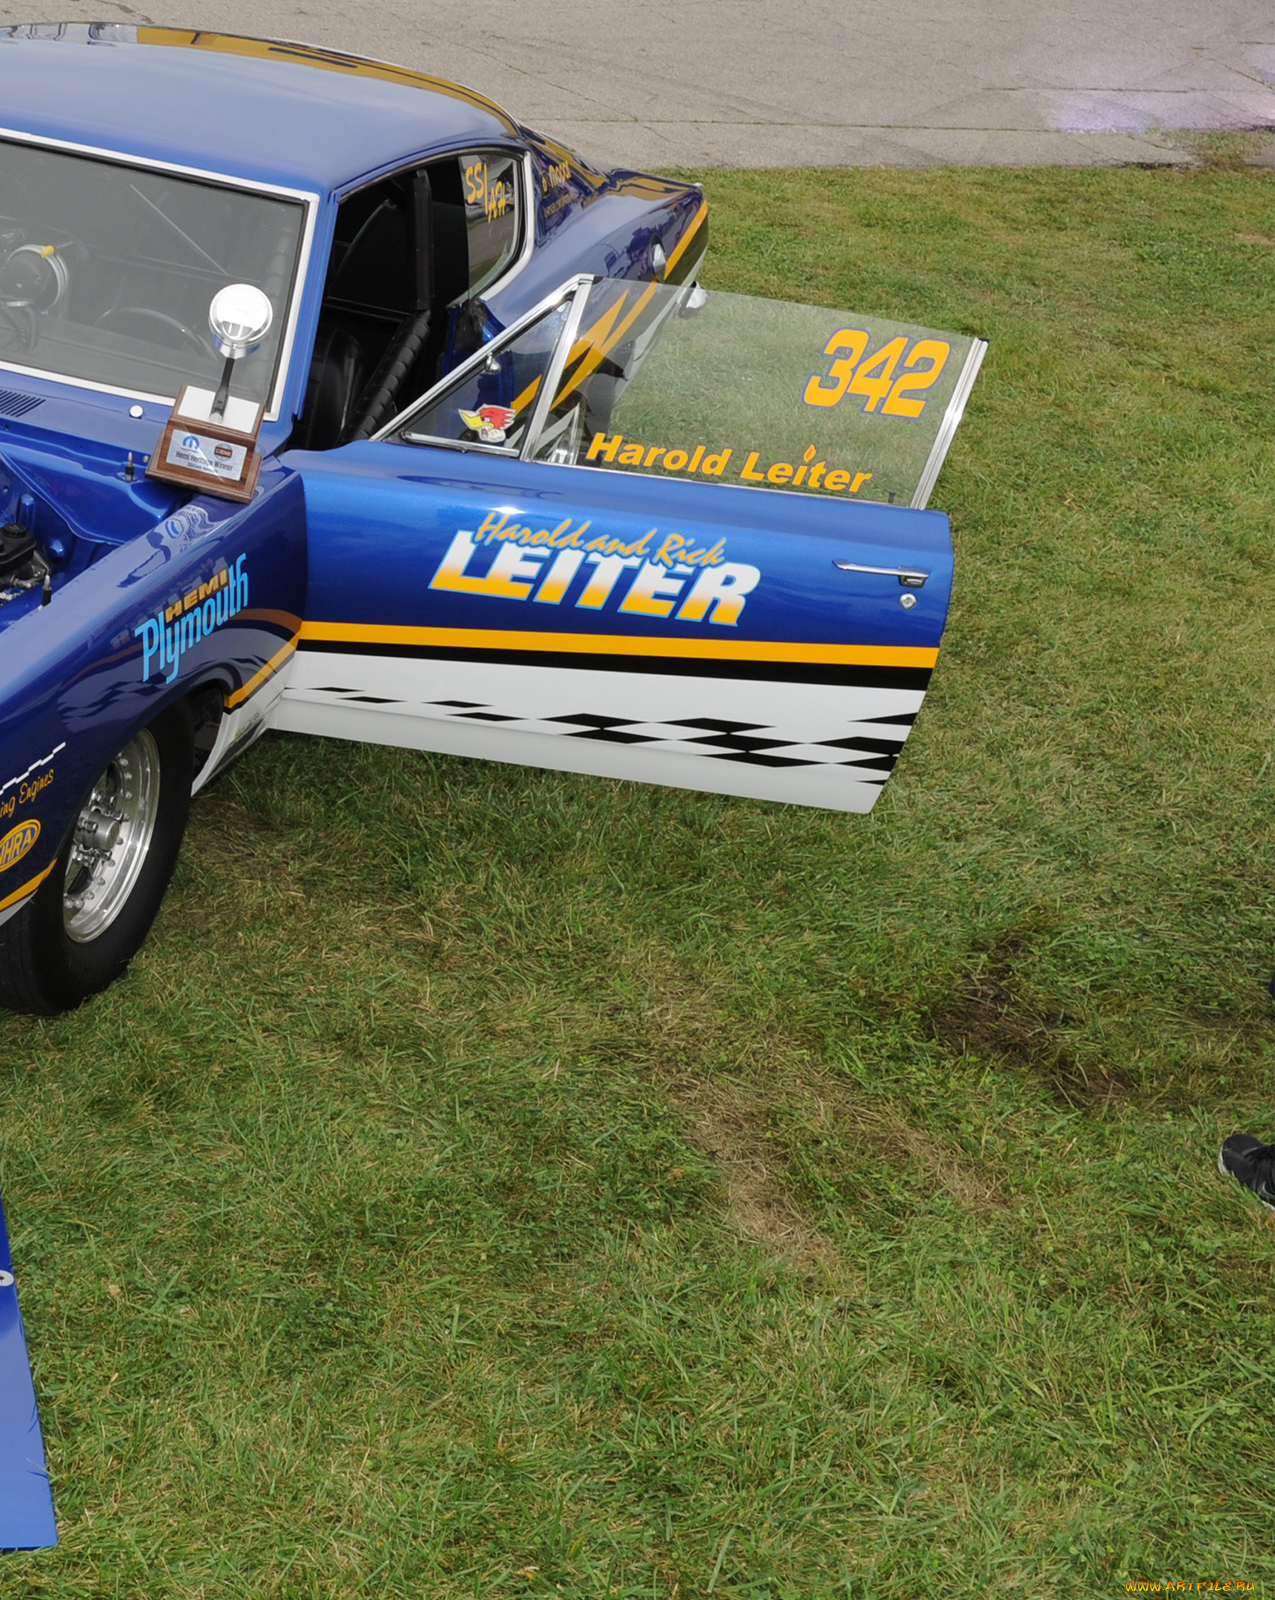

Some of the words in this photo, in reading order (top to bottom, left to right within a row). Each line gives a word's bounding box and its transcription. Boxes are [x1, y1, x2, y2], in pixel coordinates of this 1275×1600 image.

[802, 326, 952, 420] 342
[586, 431, 731, 477] Harold
[739, 444, 873, 494] Leiter
[474, 512, 585, 550] Harold
[583, 528, 658, 558] and
[654, 533, 728, 568] Rick
[165, 568, 229, 624] HEMI
[427, 529, 762, 628] LEITER
[134, 552, 249, 685] Plymouth
[18, 768, 55, 804] Engines
